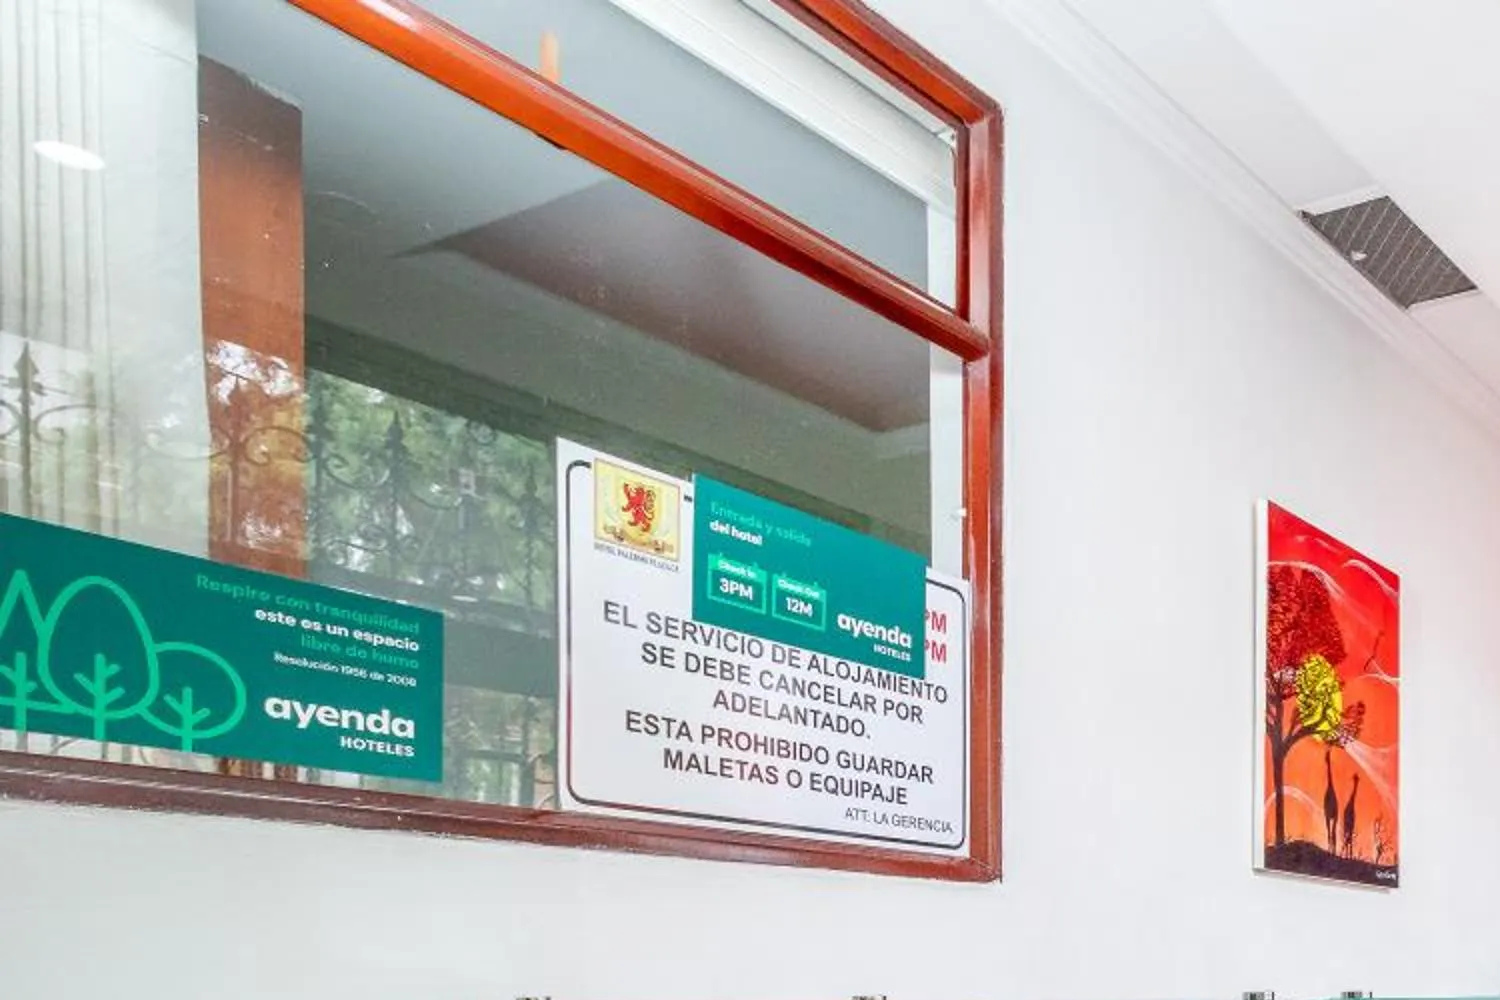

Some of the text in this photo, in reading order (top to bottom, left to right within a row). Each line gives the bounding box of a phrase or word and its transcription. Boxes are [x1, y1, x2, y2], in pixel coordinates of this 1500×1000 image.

[709, 519, 763, 546] del hotel
[719, 577, 754, 601] 3PM
[786, 596, 813, 618] 12M
[254, 608, 297, 627] este
[326, 622, 349, 638] un
[352, 629, 419, 652] espacio
[275, 593, 310, 612] con
[315, 601, 419, 634] tranquilidad
[837, 613, 912, 649] ayenda
[372, 648, 419, 669] humo
[604, 599, 948, 703] EL SERVICIO DE ALOJAMIENTO
[641, 641, 924, 724] SE DEBE CANCELAR POR
[264, 697, 415, 738] ayenda
[713, 689, 871, 739] ADELANTADO.
[339, 735, 415, 757] HOTELES
[625, 709, 934, 784] ESTA PROHIBIDO GUARDAR
[663, 747, 908, 805] MALETAS O EQUIPAJE
[873, 811, 889, 826] LA
[891, 813, 954, 834] GERENCIA
